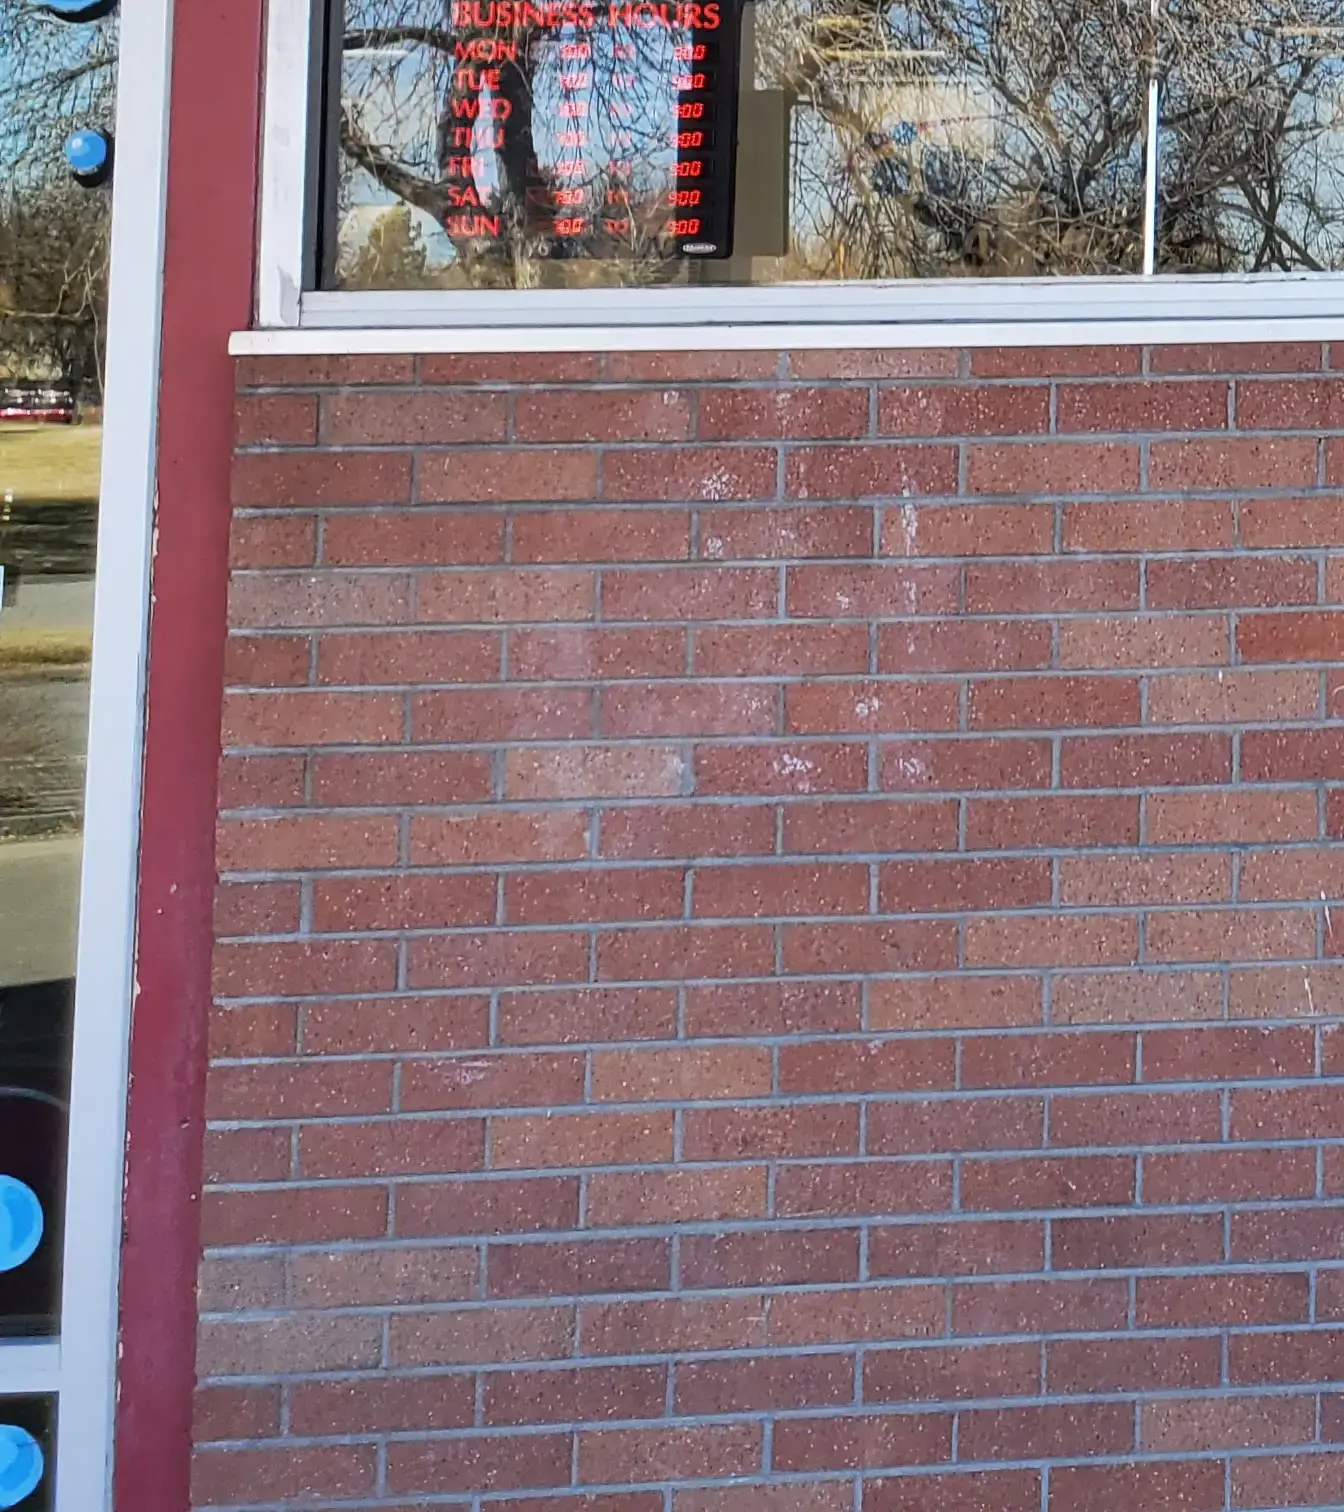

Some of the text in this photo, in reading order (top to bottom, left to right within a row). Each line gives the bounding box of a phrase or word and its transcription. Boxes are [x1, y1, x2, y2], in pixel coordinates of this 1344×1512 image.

[453, 0, 722, 31] BUSINESS HOURS
[453, 40, 518, 63] MON
[456, 68, 501, 91] TUE
[452, 97, 513, 121] WED
[452, 126, 505, 149] THU
[448, 155, 485, 178] FRI
[447, 185, 492, 207] SAT
[445, 213, 500, 238] SUN
